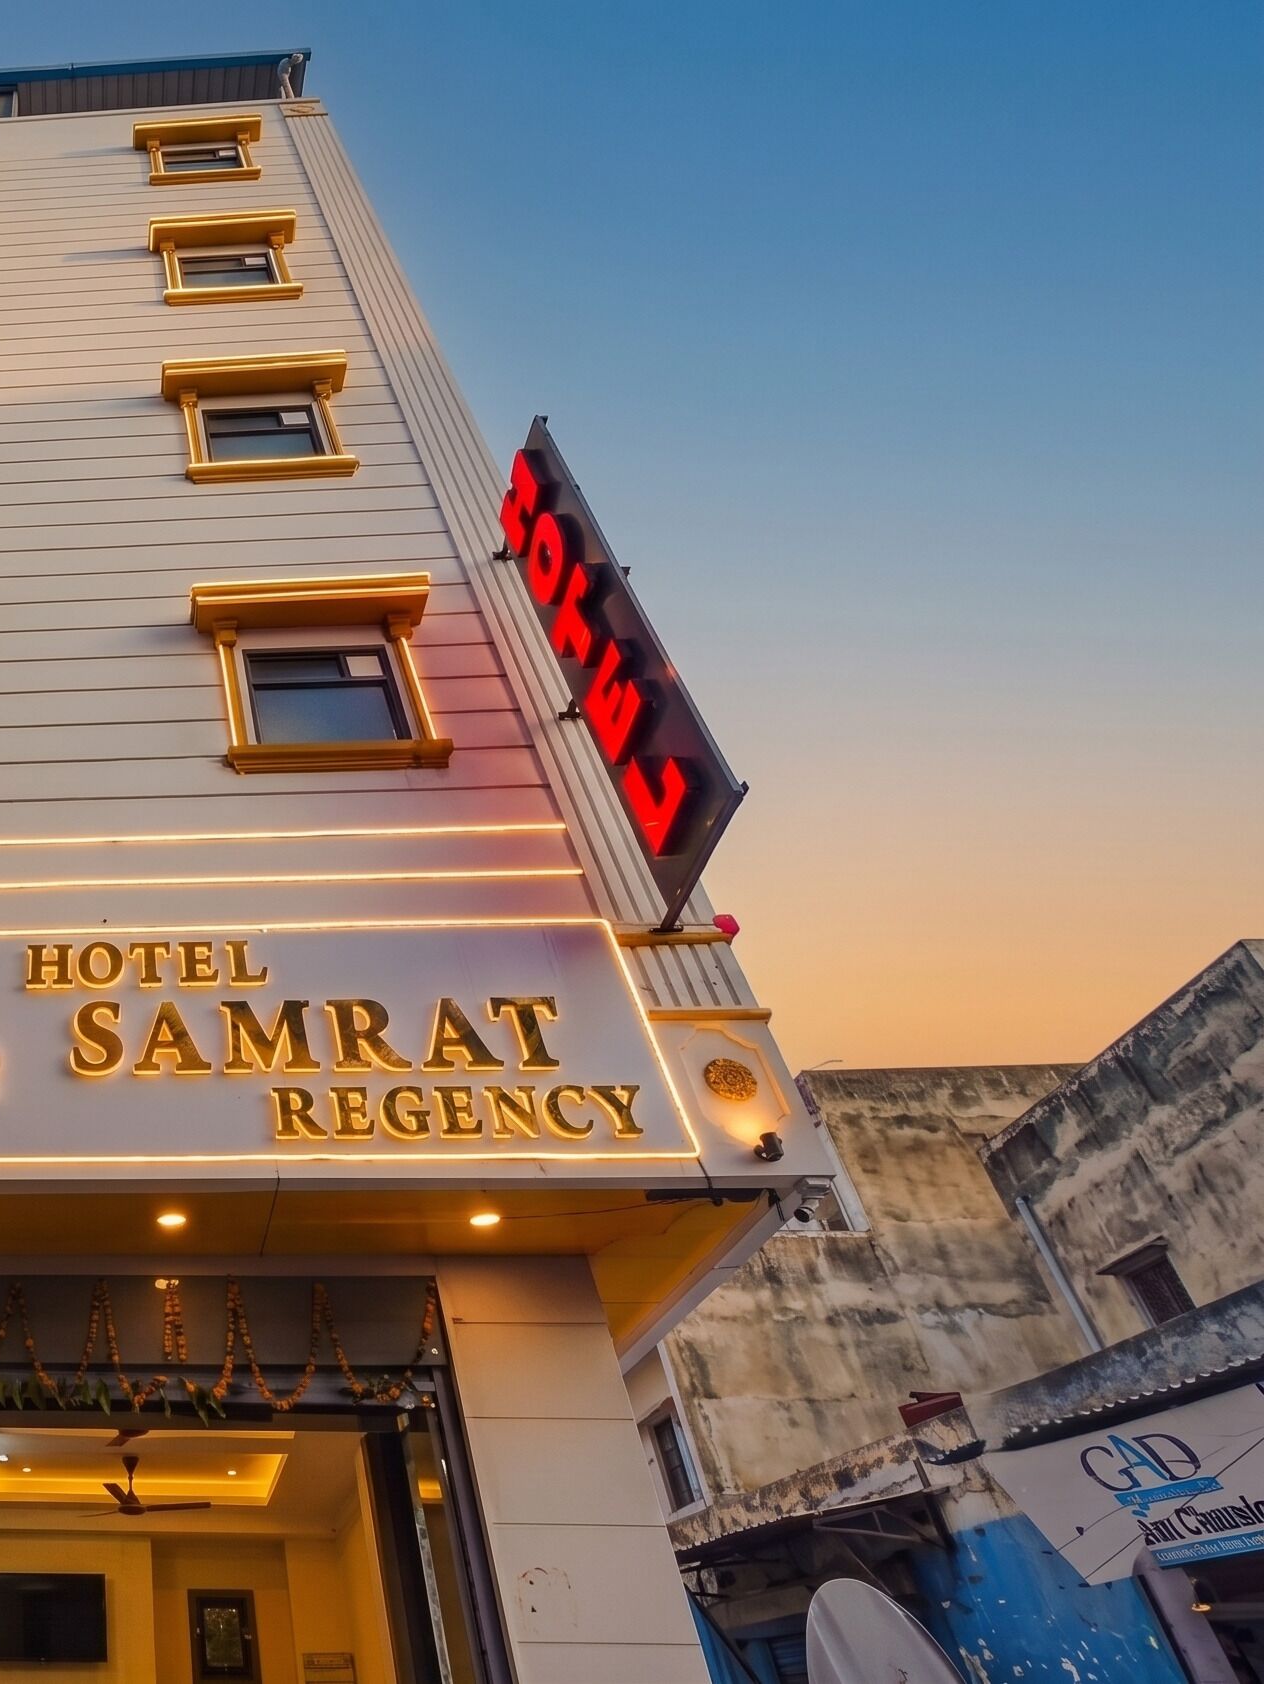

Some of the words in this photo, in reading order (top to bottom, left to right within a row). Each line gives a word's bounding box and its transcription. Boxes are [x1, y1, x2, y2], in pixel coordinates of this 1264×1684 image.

[499, 448, 688, 858] HOTEL
[25, 941, 269, 989] HOTEL
[68, 996, 560, 1076] SAMRAT
[270, 1084, 645, 1140] REGENCY
[1080, 1433, 1202, 1492] GAD
